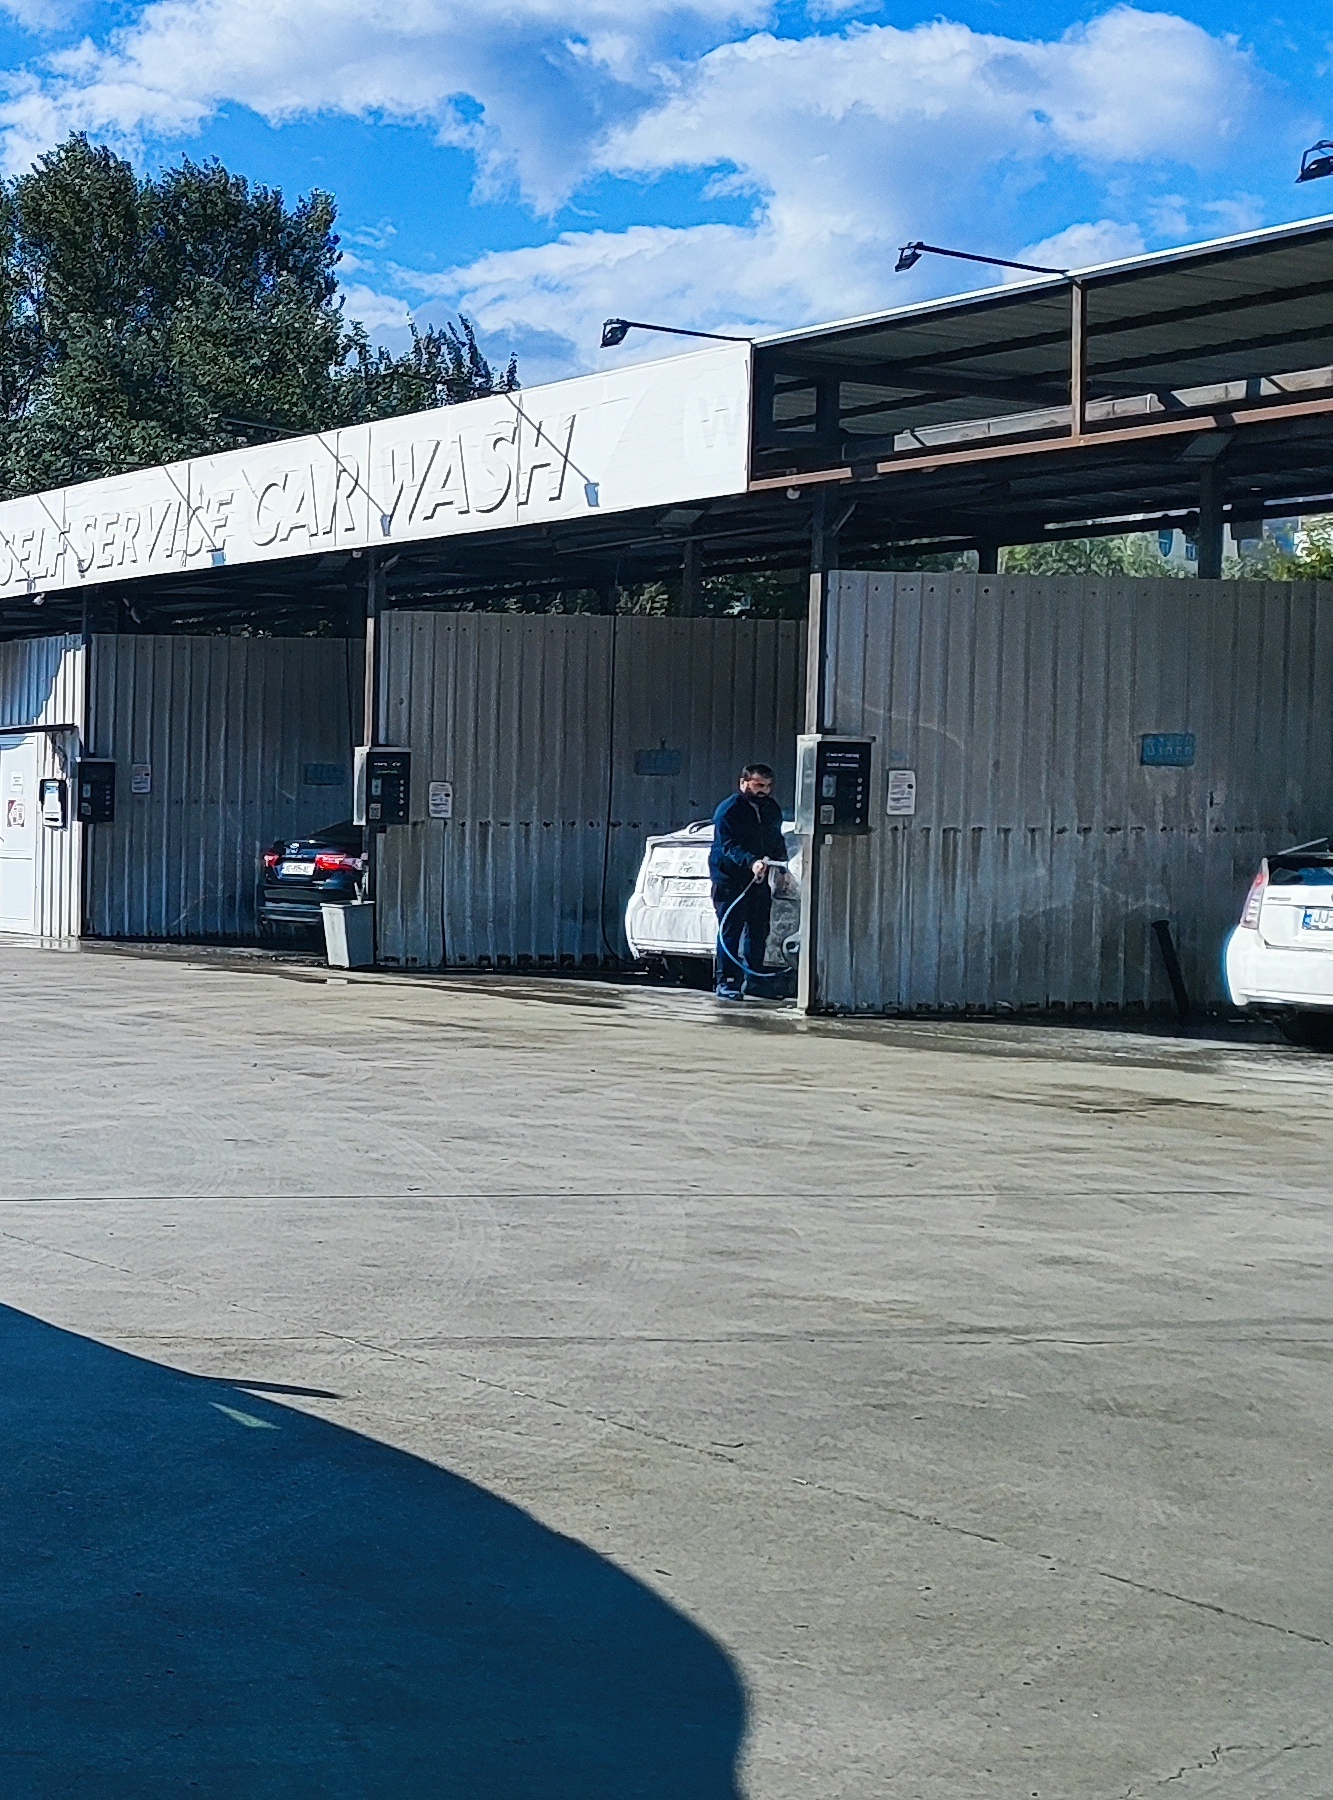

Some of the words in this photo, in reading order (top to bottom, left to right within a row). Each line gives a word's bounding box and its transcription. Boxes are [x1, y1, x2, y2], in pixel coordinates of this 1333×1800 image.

[76, 489, 235, 574] SERVICE
[250, 455, 361, 547] CAR
[382, 413, 577, 526] WASH
